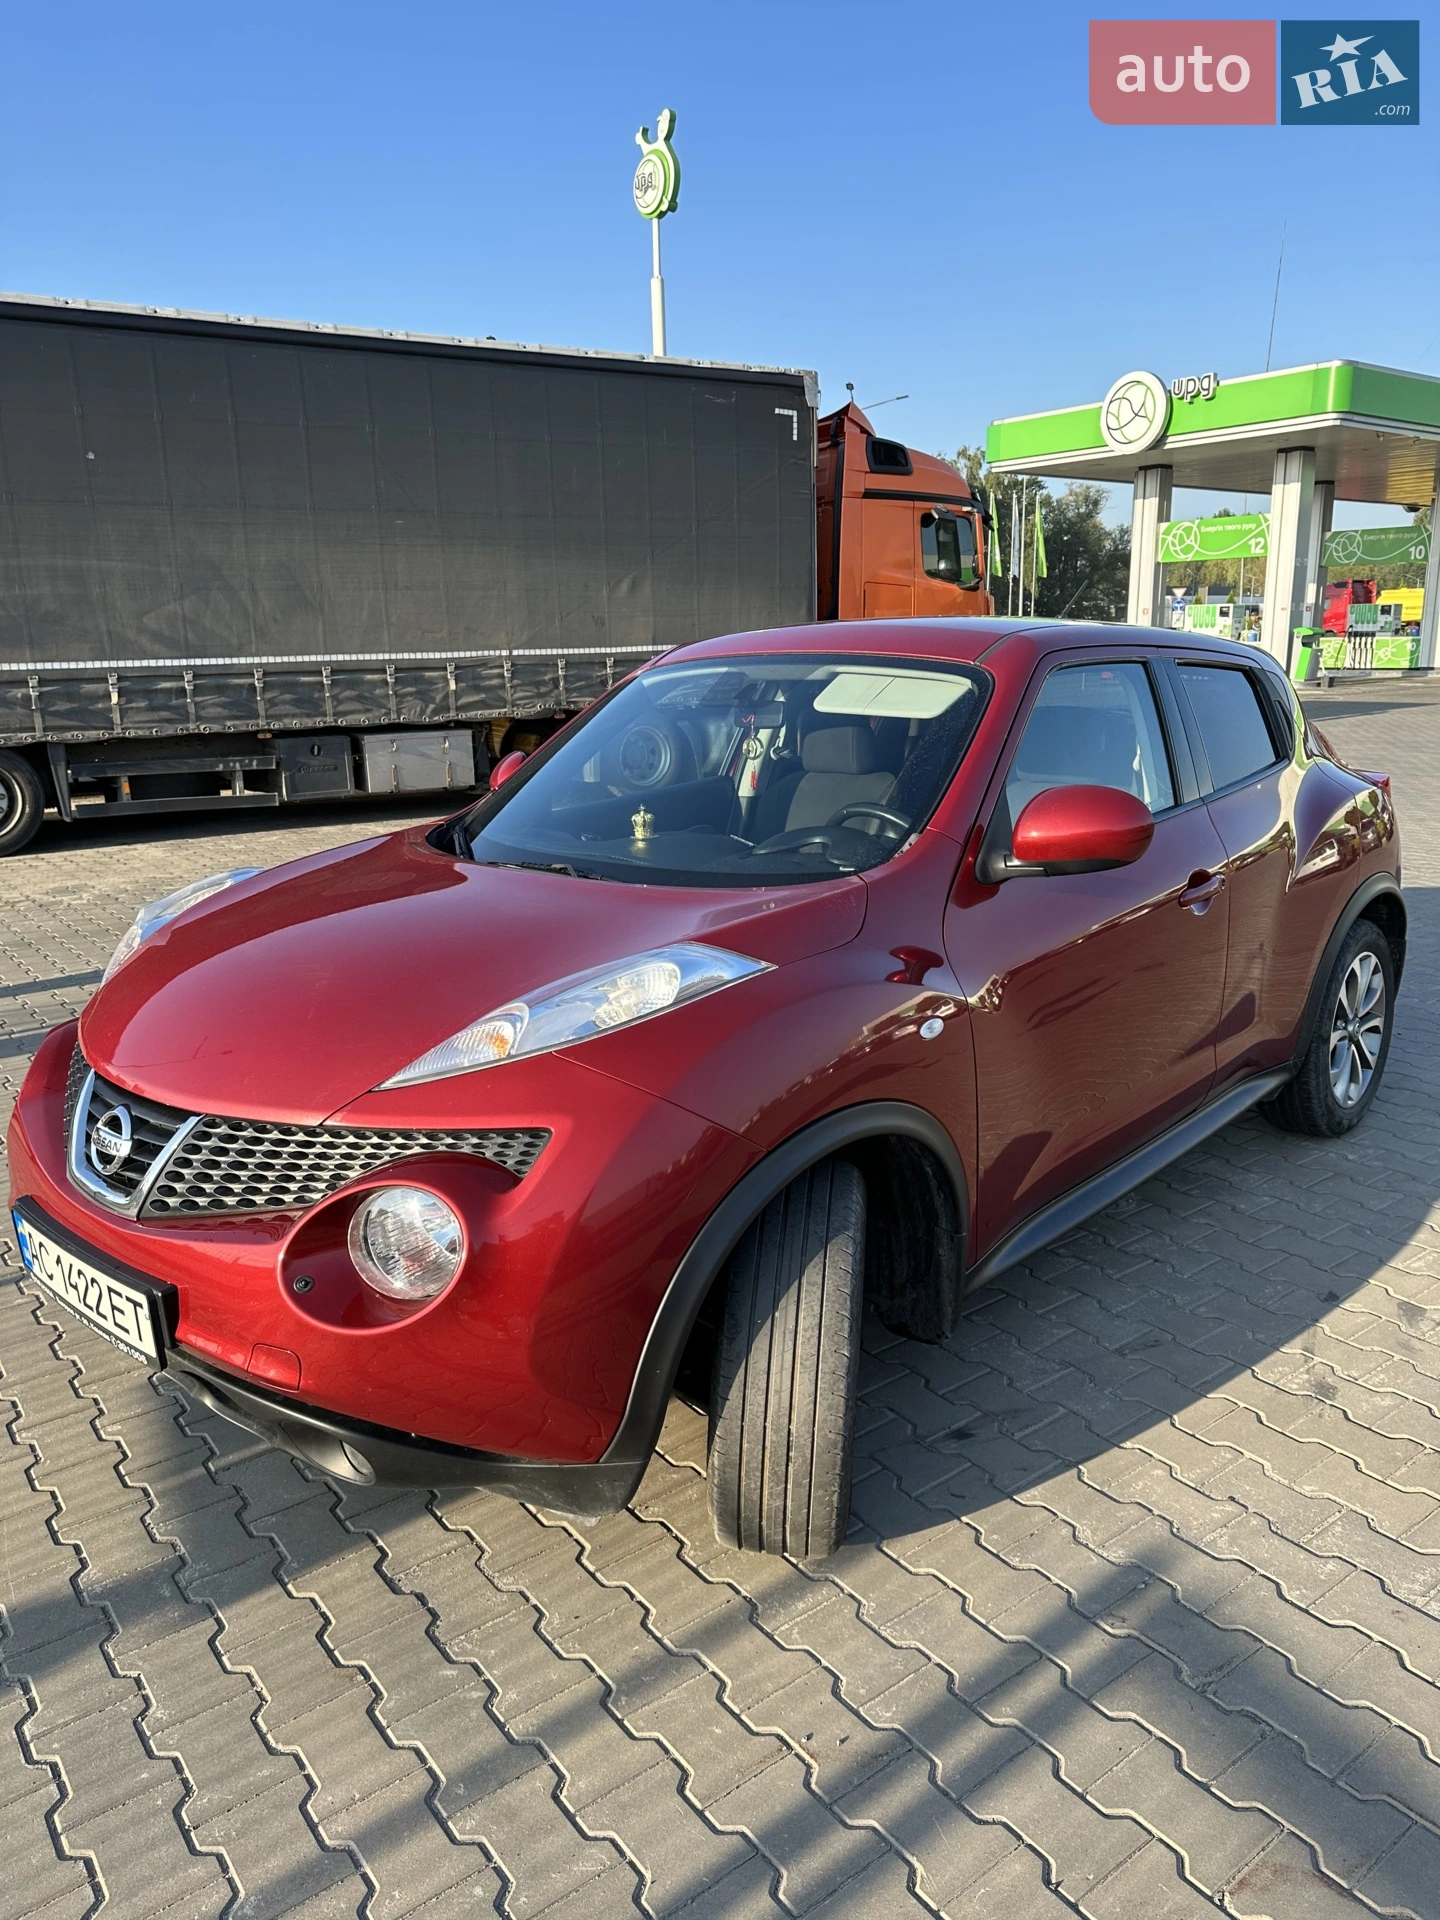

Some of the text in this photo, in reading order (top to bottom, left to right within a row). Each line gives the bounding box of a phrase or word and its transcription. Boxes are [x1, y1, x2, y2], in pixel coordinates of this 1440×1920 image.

[1172, 372, 1215, 402] upg
[1248, 537, 1265, 554] 12
[1408, 545, 1425, 560] 10
[1406, 642, 1416, 651] 10
